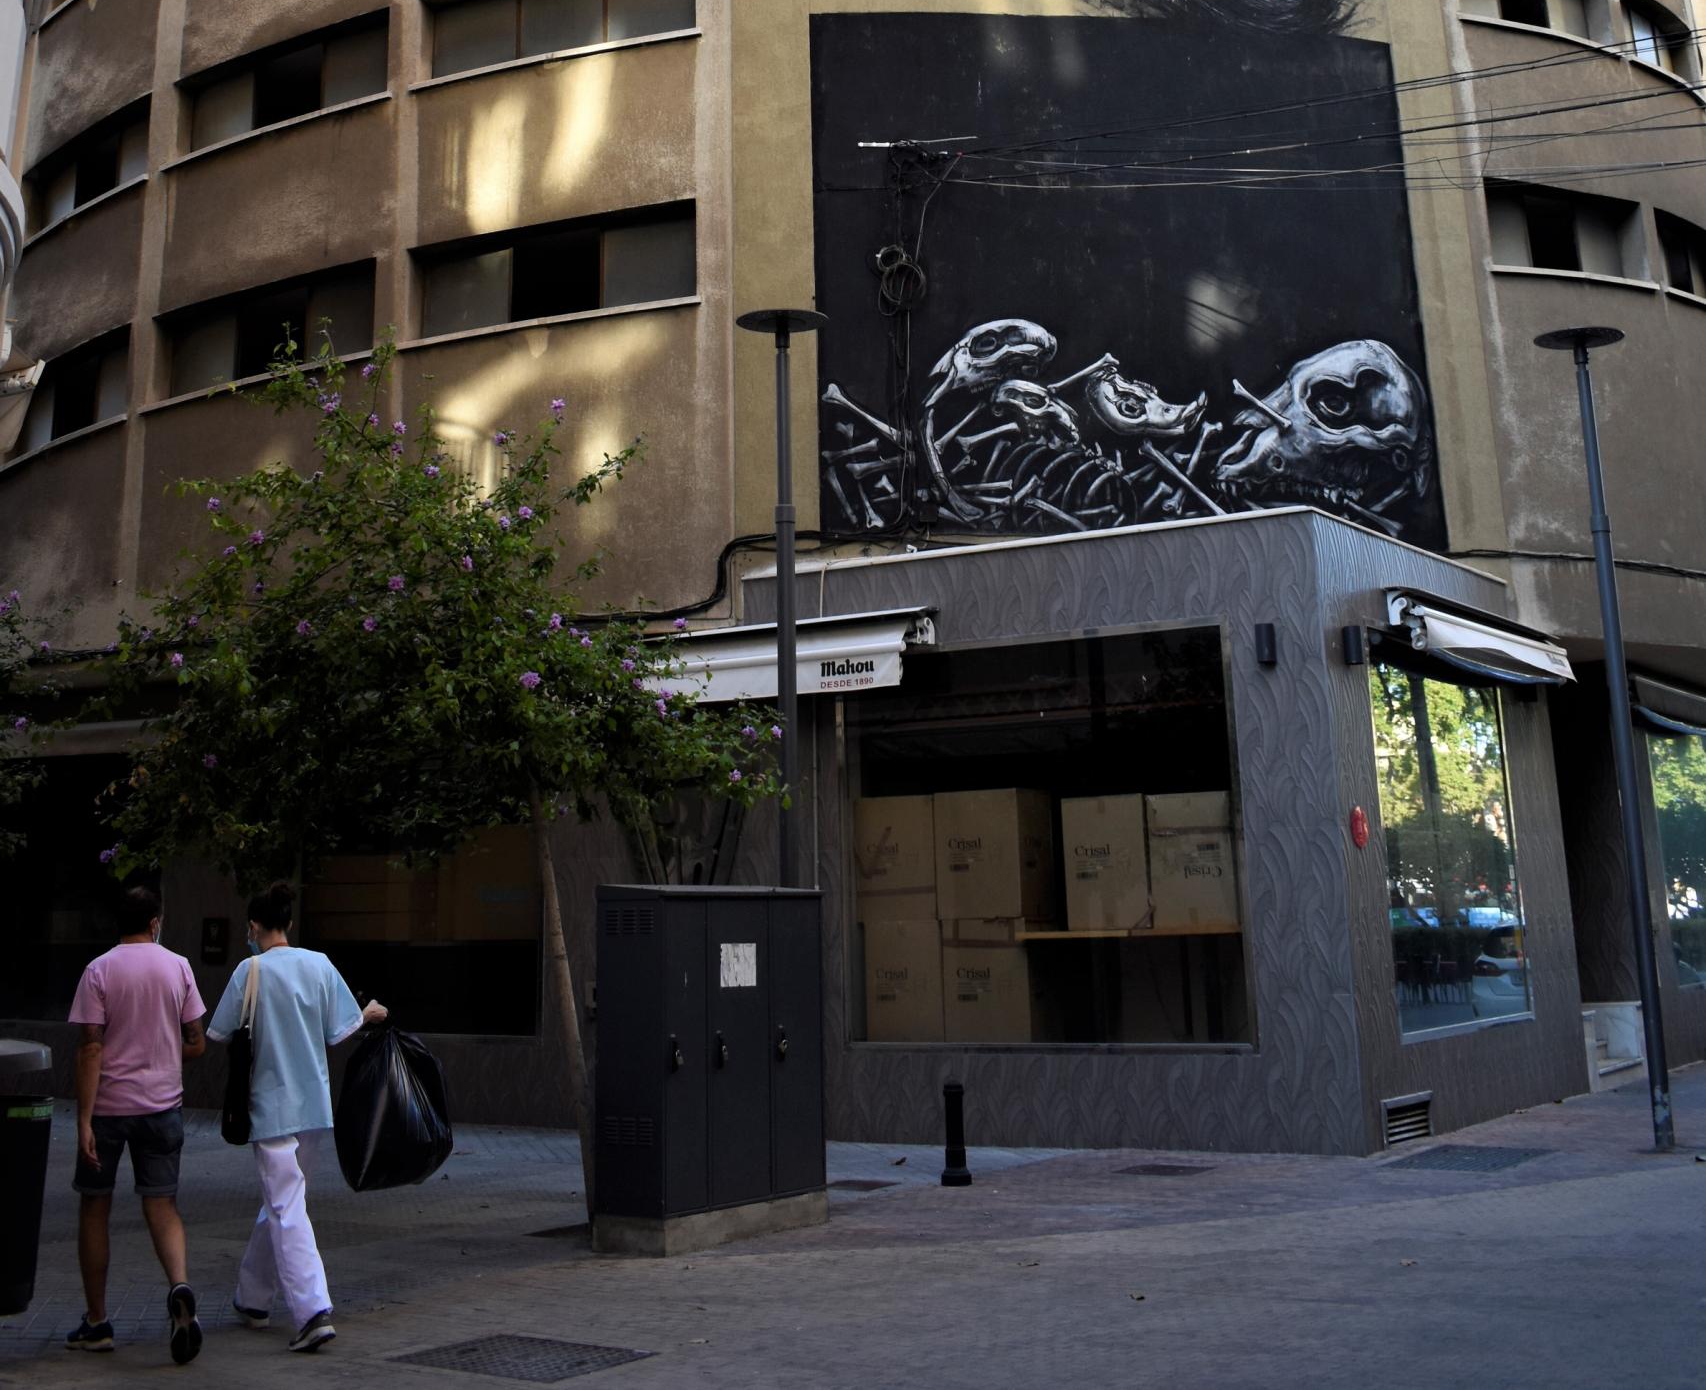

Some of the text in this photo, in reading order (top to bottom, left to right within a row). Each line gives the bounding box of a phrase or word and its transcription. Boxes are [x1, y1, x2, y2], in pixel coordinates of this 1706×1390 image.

[820, 659, 874, 677] Mahou
[821, 676, 874, 689] DESDE 1890
[949, 836, 982, 850] Crisal
[1074, 845, 1111, 858] Crisal
[1184, 865, 1223, 878] Crisal
[876, 968, 908, 980] Crisal
[957, 967, 991, 980] Crisal
